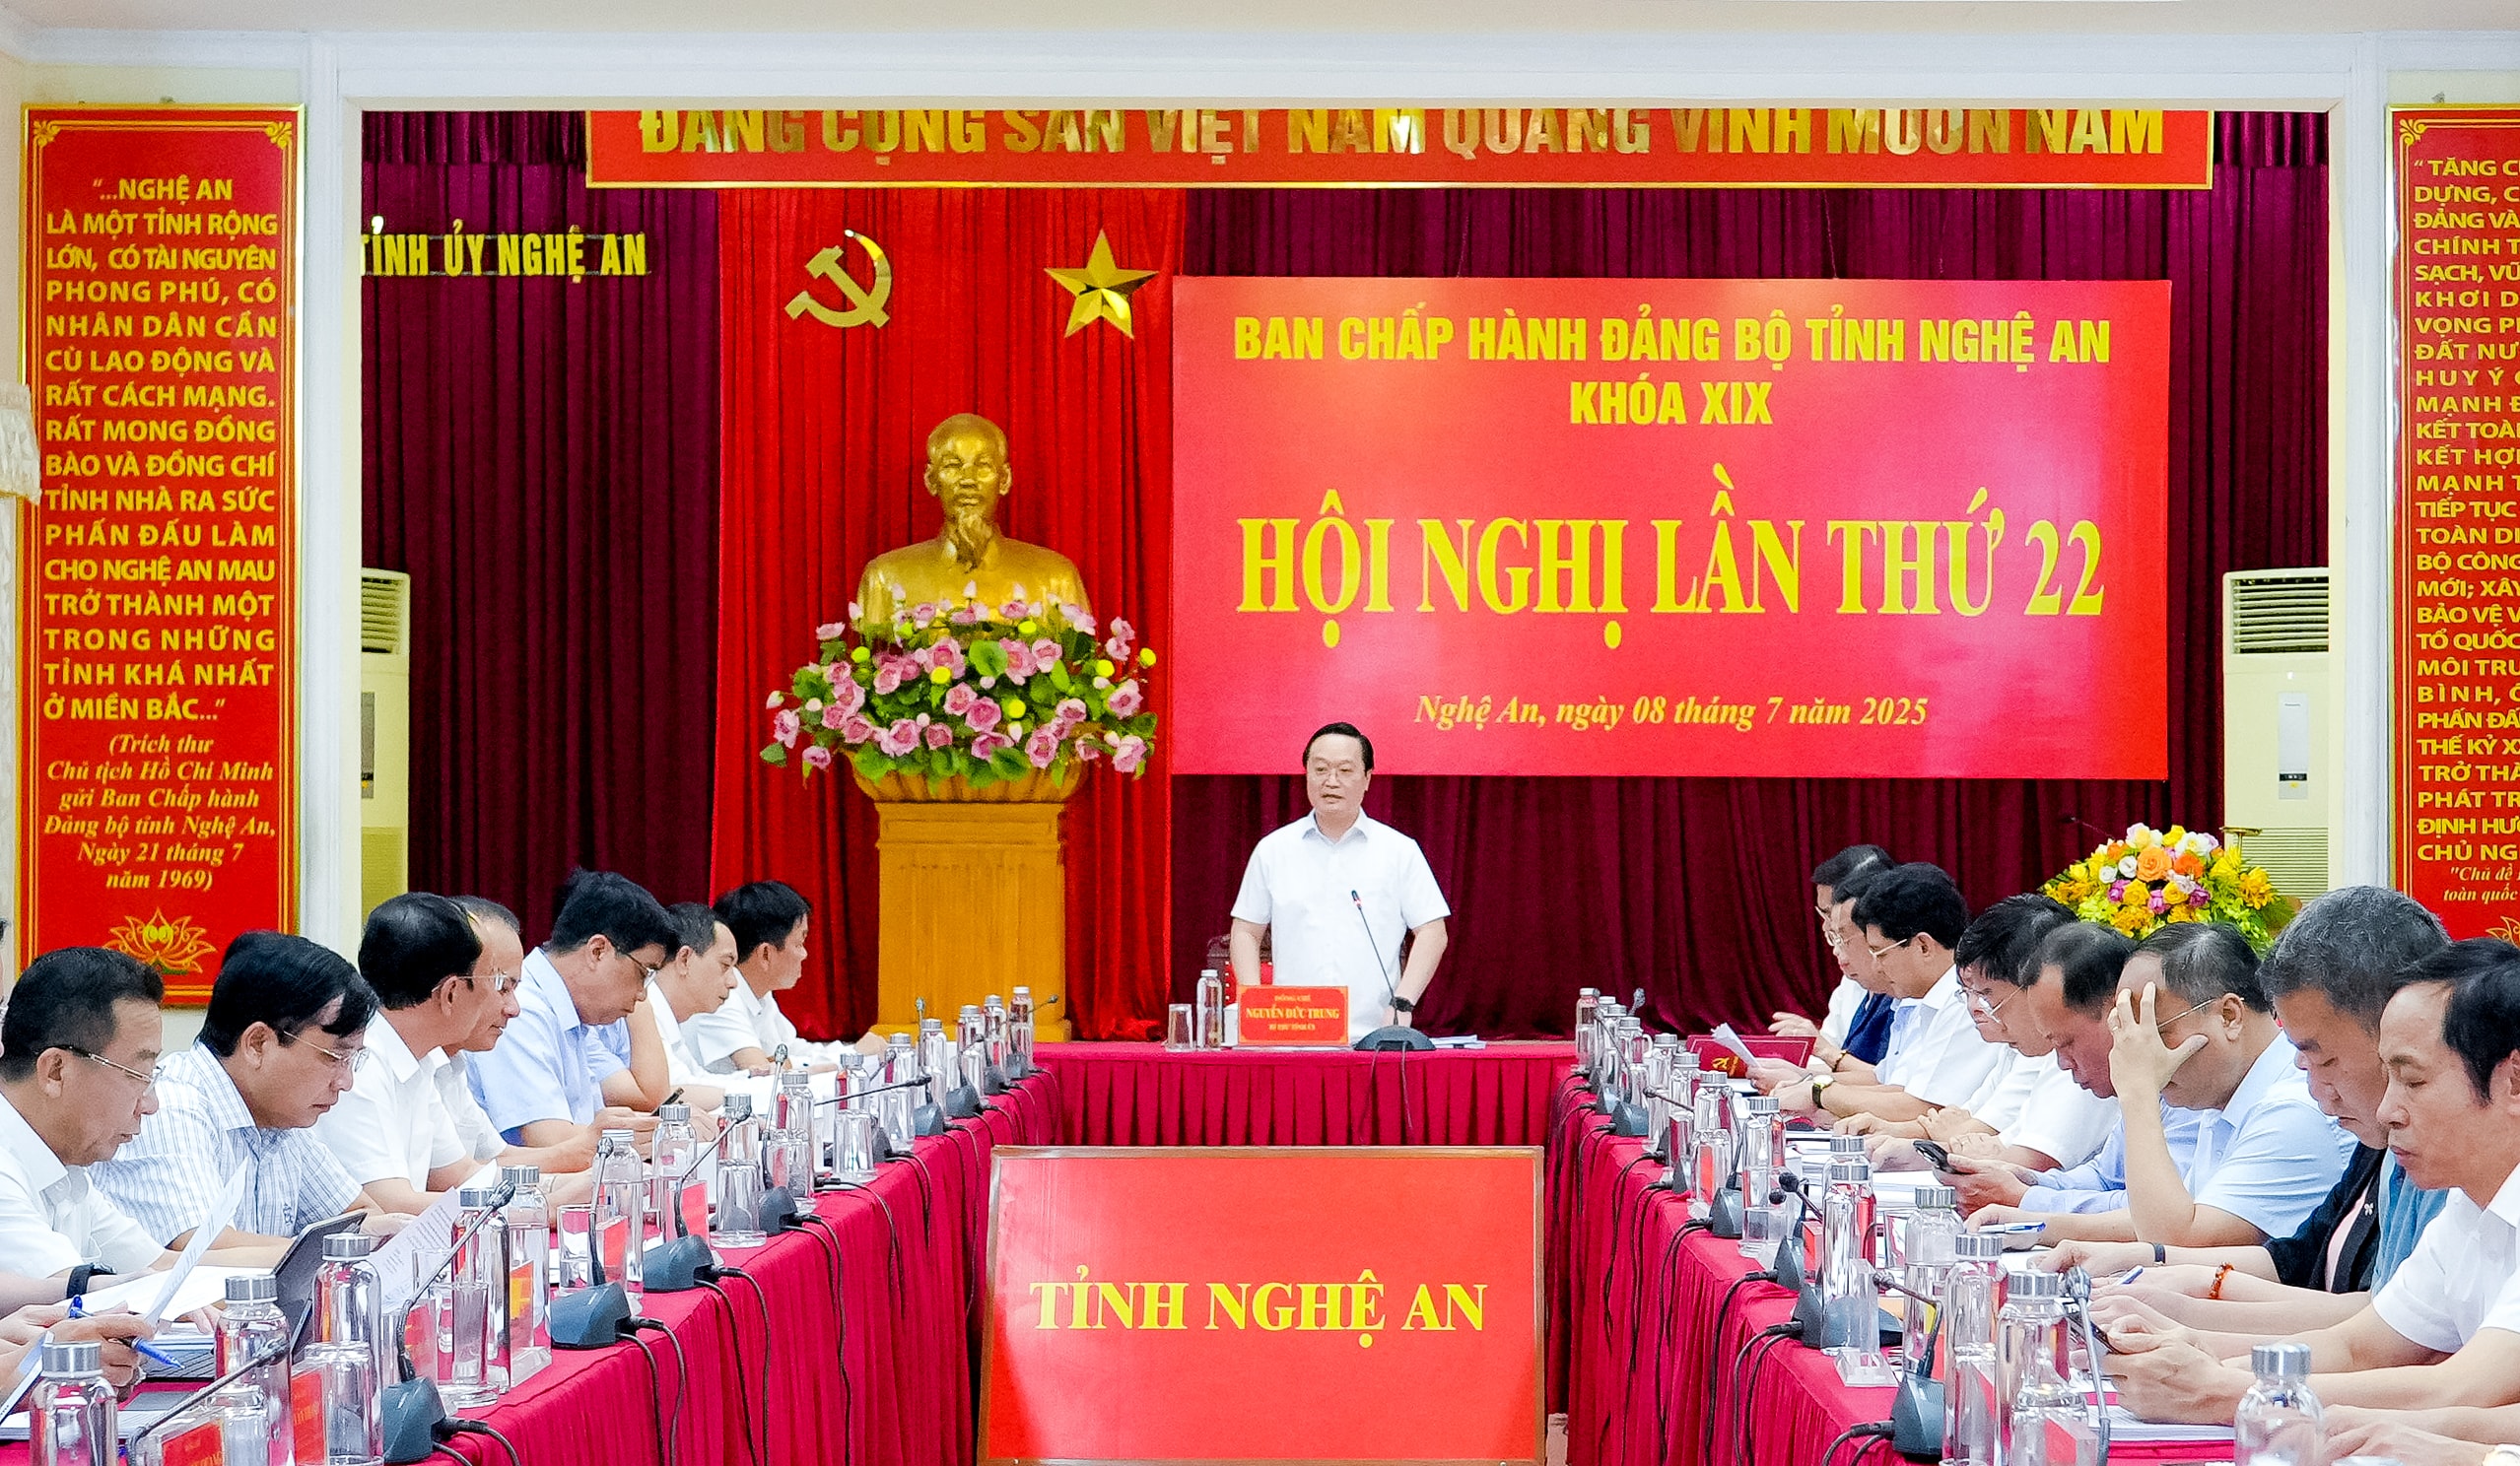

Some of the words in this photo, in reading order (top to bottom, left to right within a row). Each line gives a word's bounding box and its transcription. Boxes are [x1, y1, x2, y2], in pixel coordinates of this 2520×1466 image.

[1287, 111, 1426, 155] NAM
[1443, 111, 1650, 160] QUANG
[1671, 111, 1811, 154] VINH
[195, 178, 233, 200] AN
[2415, 184, 2497, 207] DỰNG,
[47, 209, 77, 233] LÀ
[83, 209, 138, 240] MỘT
[143, 207, 201, 234] TỈNH
[208, 209, 277, 240] RỘNG
[2414, 208, 2485, 229] ĐẢNG
[2488, 210, 2520, 228] VÀ
[443, 219, 485, 276] ỦY
[498, 226, 585, 283] NGHỆ
[601, 233, 646, 275] AN
[2415, 235, 2499, 254] CHÍNH
[47, 243, 98, 272] LỚN,
[108, 243, 140, 270] CÓ
[143, 243, 177, 269] TÀI
[182, 244, 277, 270] NGUYÊN
[2416, 265, 2484, 285] SẠCH,
[47, 280, 151, 302] PHONG
[161, 277, 229, 305] PHÚ,
[238, 277, 277, 303] CÓ
[2416, 290, 2488, 307] KHƠI
[47, 311, 132, 336] NHÂN
[143, 311, 206, 337] DÂN
[2415, 317, 2491, 338] VỌNG
[1236, 317, 1324, 360] BAN
[1339, 303, 1454, 360] CHẤP
[1469, 308, 1586, 360] HÀNH
[1601, 303, 1720, 361] ĐẢNG
[1737, 309, 1792, 369] BỘ
[1806, 304, 1904, 361] TỈNH
[1922, 312, 2034, 370] NGHỆ
[2051, 321, 2109, 363] AN
[2414, 339, 2470, 360] ĐẤT
[45, 346, 82, 371] CÙ
[91, 351, 145, 371] LAO
[150, 347, 233, 377] ĐỘNG
[238, 346, 276, 372] VÀ
[2414, 370, 2479, 386] HUY
[2488, 367, 2504, 385] Ý
[46, 378, 97, 406] RẤT
[102, 381, 175, 407] CÁCH
[183, 385, 276, 413] MẠNG.
[1570, 376, 1687, 426] KHÓA
[1701, 380, 1773, 425] XIX
[2417, 396, 2500, 417] MẠNH
[46, 414, 96, 440] RẤT
[103, 420, 187, 441] MONG
[194, 414, 277, 442] ĐỒNG
[2417, 418, 2462, 438] KẾT
[46, 451, 101, 476] BÀO
[105, 451, 140, 477] VÀ
[146, 449, 225, 477] ĐỒNG
[231, 450, 276, 477] CHÍ
[2417, 444, 2466, 465] KẾT
[2417, 475, 2503, 496] MẠNH
[45, 484, 107, 510] TỈNH
[116, 486, 172, 511] NHÀ
[180, 490, 215, 511] RA
[222, 486, 275, 512] SỨC
[2416, 497, 2466, 517] TIẾP
[2469, 501, 2517, 521] TỤC
[46, 518, 129, 546] PHẤN
[138, 518, 201, 547] ĐẤU
[212, 520, 275, 547] LÀM
[2416, 525, 2486, 544] TOÀN
[1238, 489, 1395, 648] HỘI
[1419, 517, 1628, 649] NGHỊ
[1652, 463, 1805, 614] LẦN
[1828, 489, 2005, 616] THỨ
[2026, 521, 2104, 616] 22
[2418, 552, 2451, 574] BỘ
[45, 560, 98, 580] CHO
[103, 556, 171, 586] NGHỆ
[175, 560, 212, 581] AN
[218, 560, 275, 581] MAU
[2418, 577, 2474, 598] MỚI;
[44, 588, 101, 616] TRỞ
[105, 590, 204, 616] THÀNH
[212, 590, 274, 622] MỘT
[2418, 602, 2468, 623] BẢO
[2472, 604, 2502, 627] VỆ
[44, 629, 150, 650] TRONG
[162, 625, 275, 651] NHỮNG
[2416, 629, 2448, 649] TỔ
[44, 657, 114, 685] TỈNH
[125, 660, 184, 685] KHÁ
[195, 658, 274, 686] NHẤT
[2418, 657, 2468, 676] MÔI
[2418, 683, 2500, 705] BÌNH,
[44, 692, 65, 719] Ở
[71, 692, 138, 720] MIỀN
[1415, 695, 1491, 729] Nghệ
[1504, 698, 1546, 726] An,
[1556, 697, 1624, 731] ngày
[1633, 697, 1667, 723] 08
[1674, 697, 1756, 731] tháng
[1769, 697, 1783, 720] 7
[1791, 699, 1851, 724] năm
[1861, 698, 1928, 725] 2025
[2418, 707, 2482, 728] PHẤN
[177, 734, 214, 753] thư
[2417, 734, 2464, 755] THẾ
[2468, 734, 2497, 755] KỶ
[96, 761, 132, 784] tịch
[140, 756, 170, 780] Hồ
[219, 762, 273, 780] Minh
[2418, 761, 2472, 781] TRỞ
[101, 788, 141, 807] Ban
[148, 783, 201, 812] Chấp
[208, 788, 259, 808] hành
[2418, 788, 2486, 808] PHÁT
[44, 815, 99, 838] Đảng
[104, 815, 129, 838] bộ
[181, 816, 236, 839] Nghệ
[240, 817, 275, 836] An,
[2417, 819, 2476, 838] ĐỊNH
[78, 842, 130, 866] Ngày
[136, 842, 159, 861] 21
[166, 842, 225, 866] tháng
[233, 843, 243, 860] 7
[2418, 839, 2472, 860] CHỦ
[106, 870, 150, 888] năm
[158, 870, 212, 891] 1969)
[2495, 863, 2512, 880] đề
[2444, 887, 2476, 900] toàn
[2482, 883, 2518, 904] quốc
[1308, 1008, 1339, 1020] TRUNG
[1029, 1264, 1189, 1329] TỈNH
[1206, 1269, 1385, 1348] NGHỆ
[1402, 1284, 1487, 1330] AN
